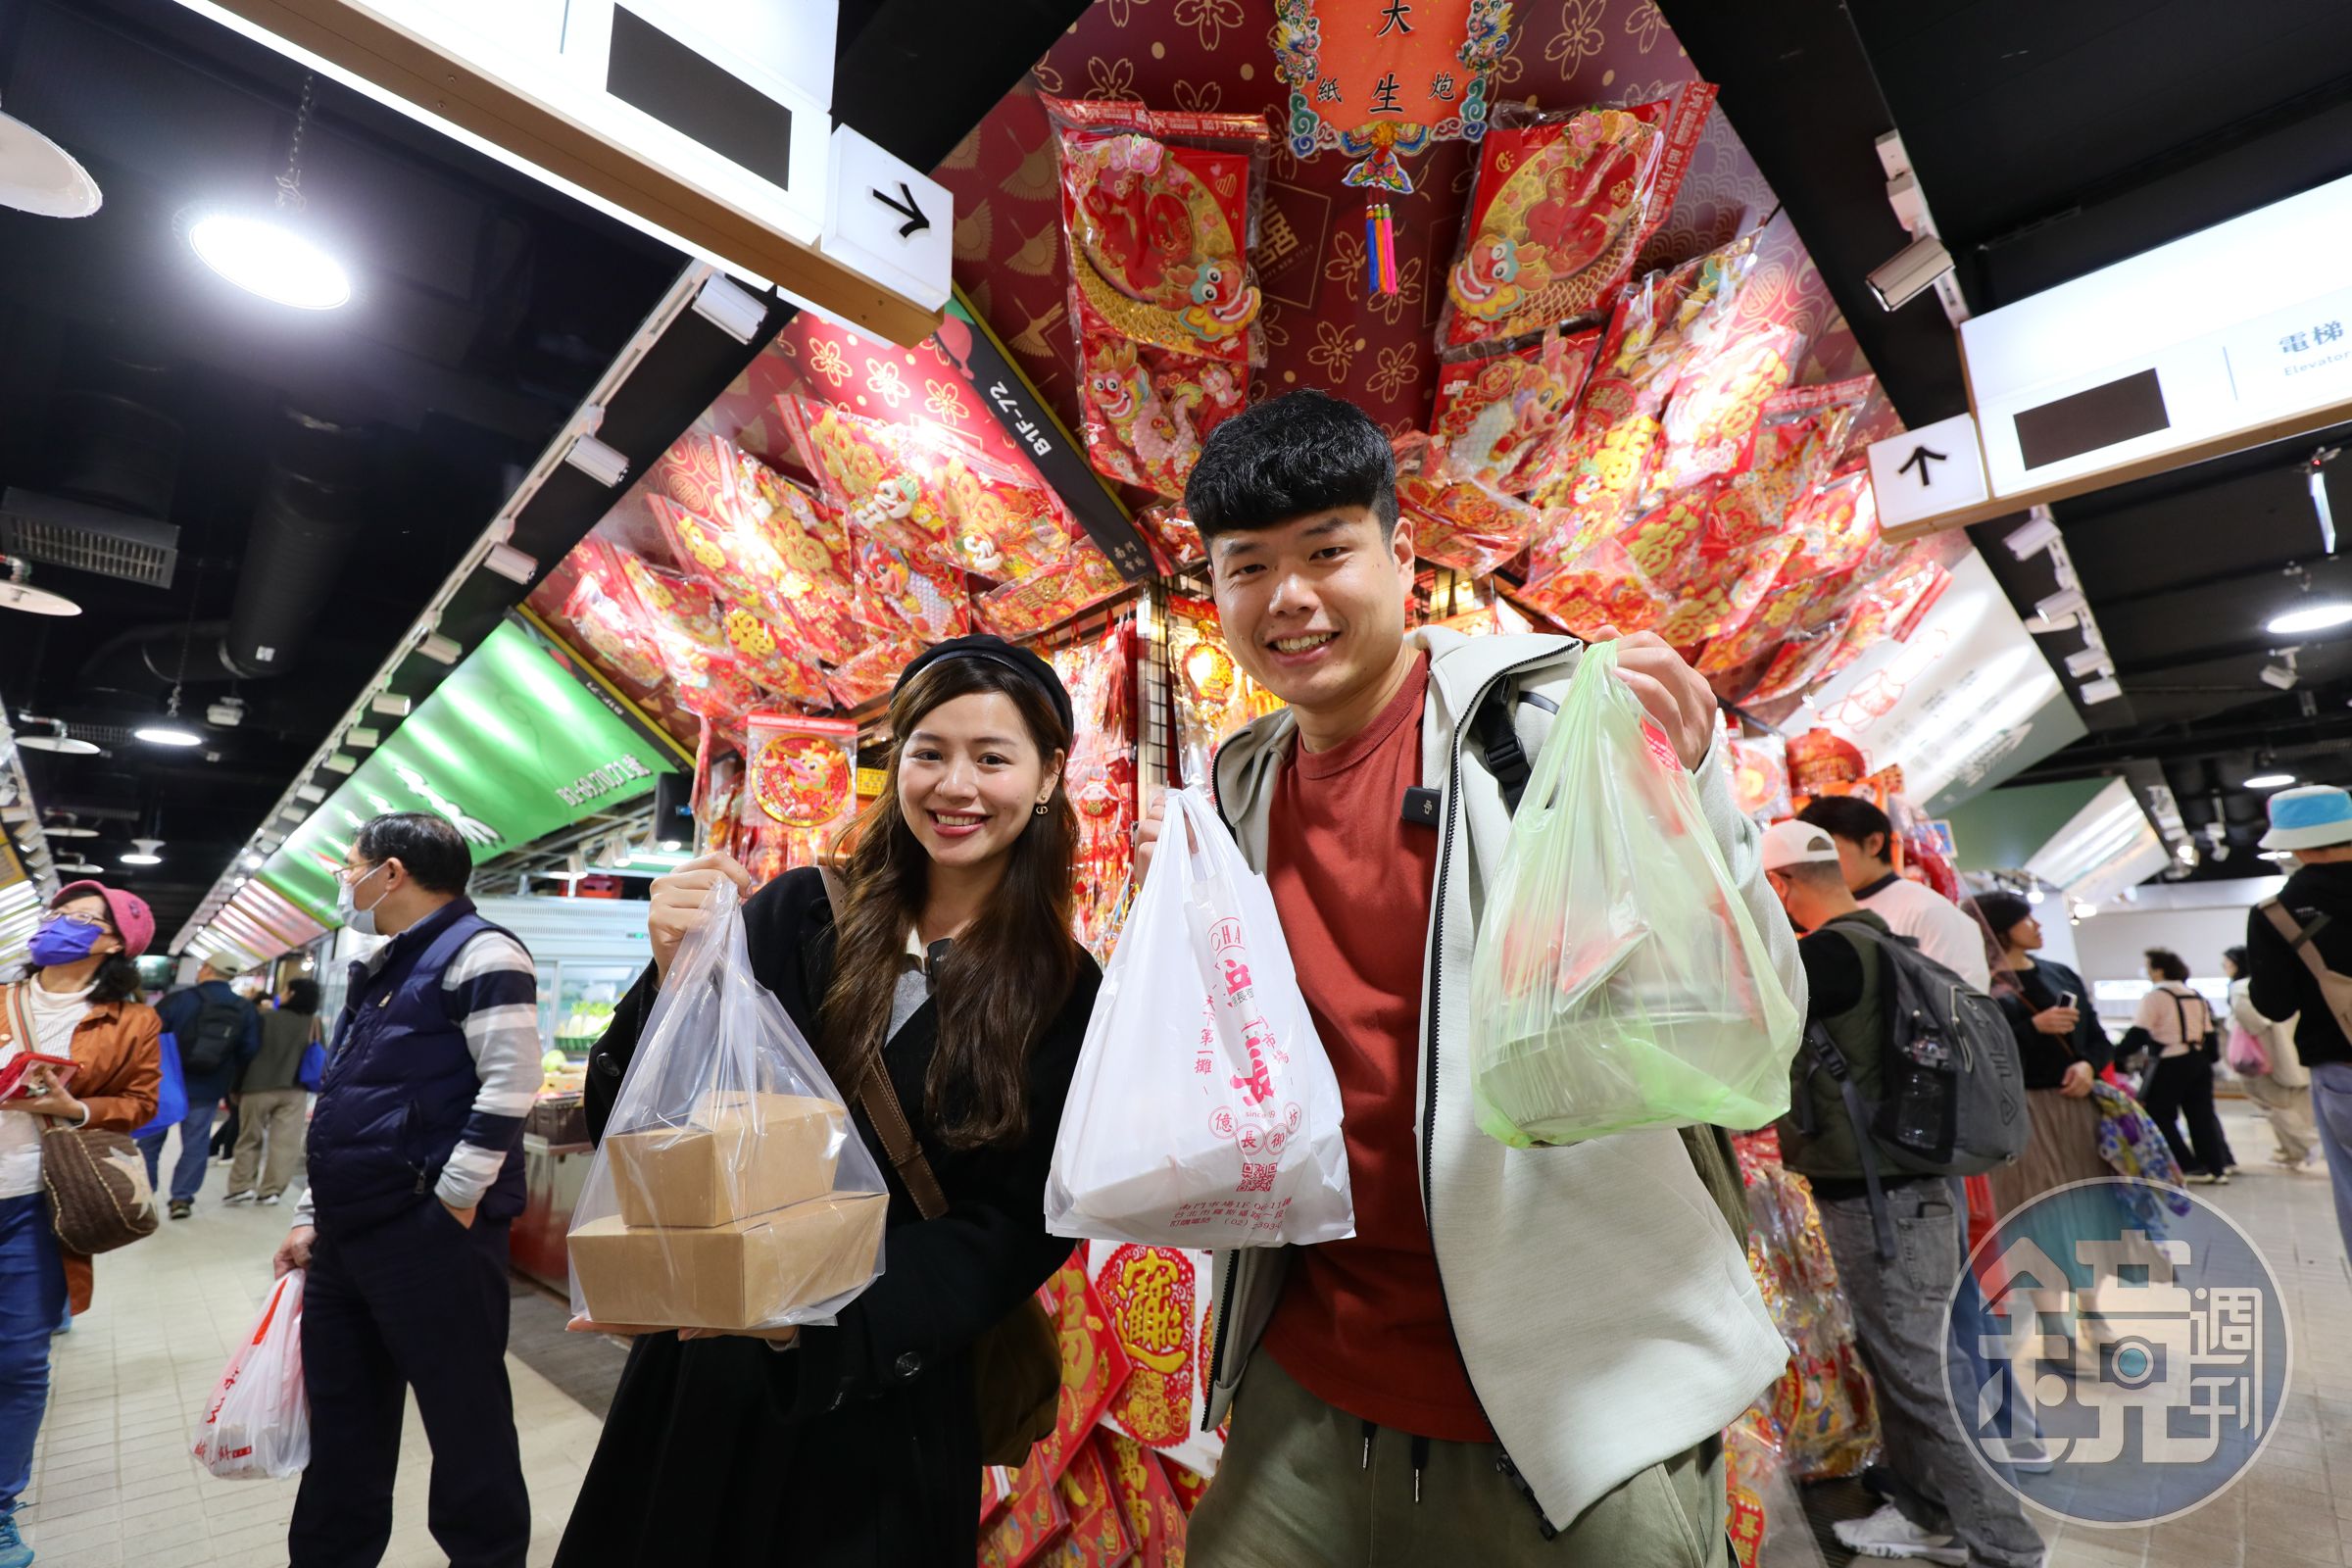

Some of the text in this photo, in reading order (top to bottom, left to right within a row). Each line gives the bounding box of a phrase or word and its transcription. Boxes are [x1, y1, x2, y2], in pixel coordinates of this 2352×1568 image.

[2279, 319, 2344, 354] 電梯
[2283, 351, 2351, 376] Elevator
[990, 380, 1053, 457] B1F-72
